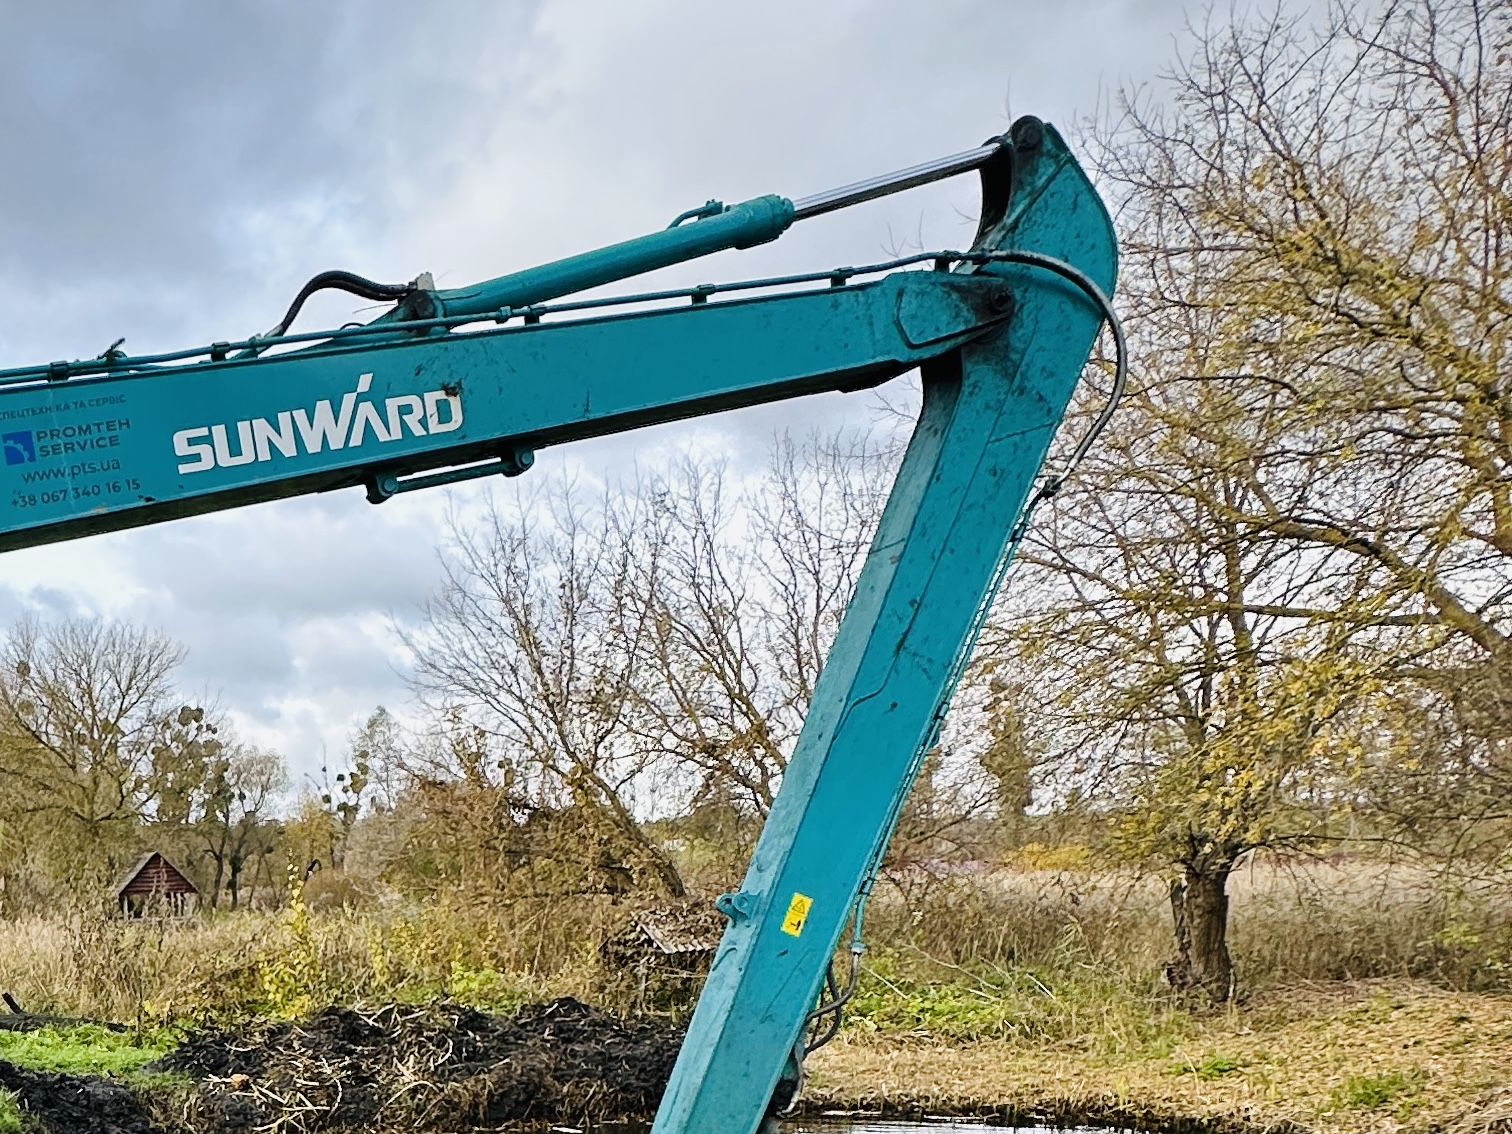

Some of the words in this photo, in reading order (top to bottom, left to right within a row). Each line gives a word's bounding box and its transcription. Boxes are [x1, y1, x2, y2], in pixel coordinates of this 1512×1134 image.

[36, 418, 131, 442] PROMTEH
[173, 373, 463, 474] SUNWARD
[39, 435, 120, 457] SERVICE
[21, 458, 121, 484] www.pts.ua
[11, 493, 37, 508] +38
[41, 488, 68, 504] 067
[73, 484, 101, 500] 340
[105, 481, 121, 495] 16
[125, 478, 141, 490] 15
